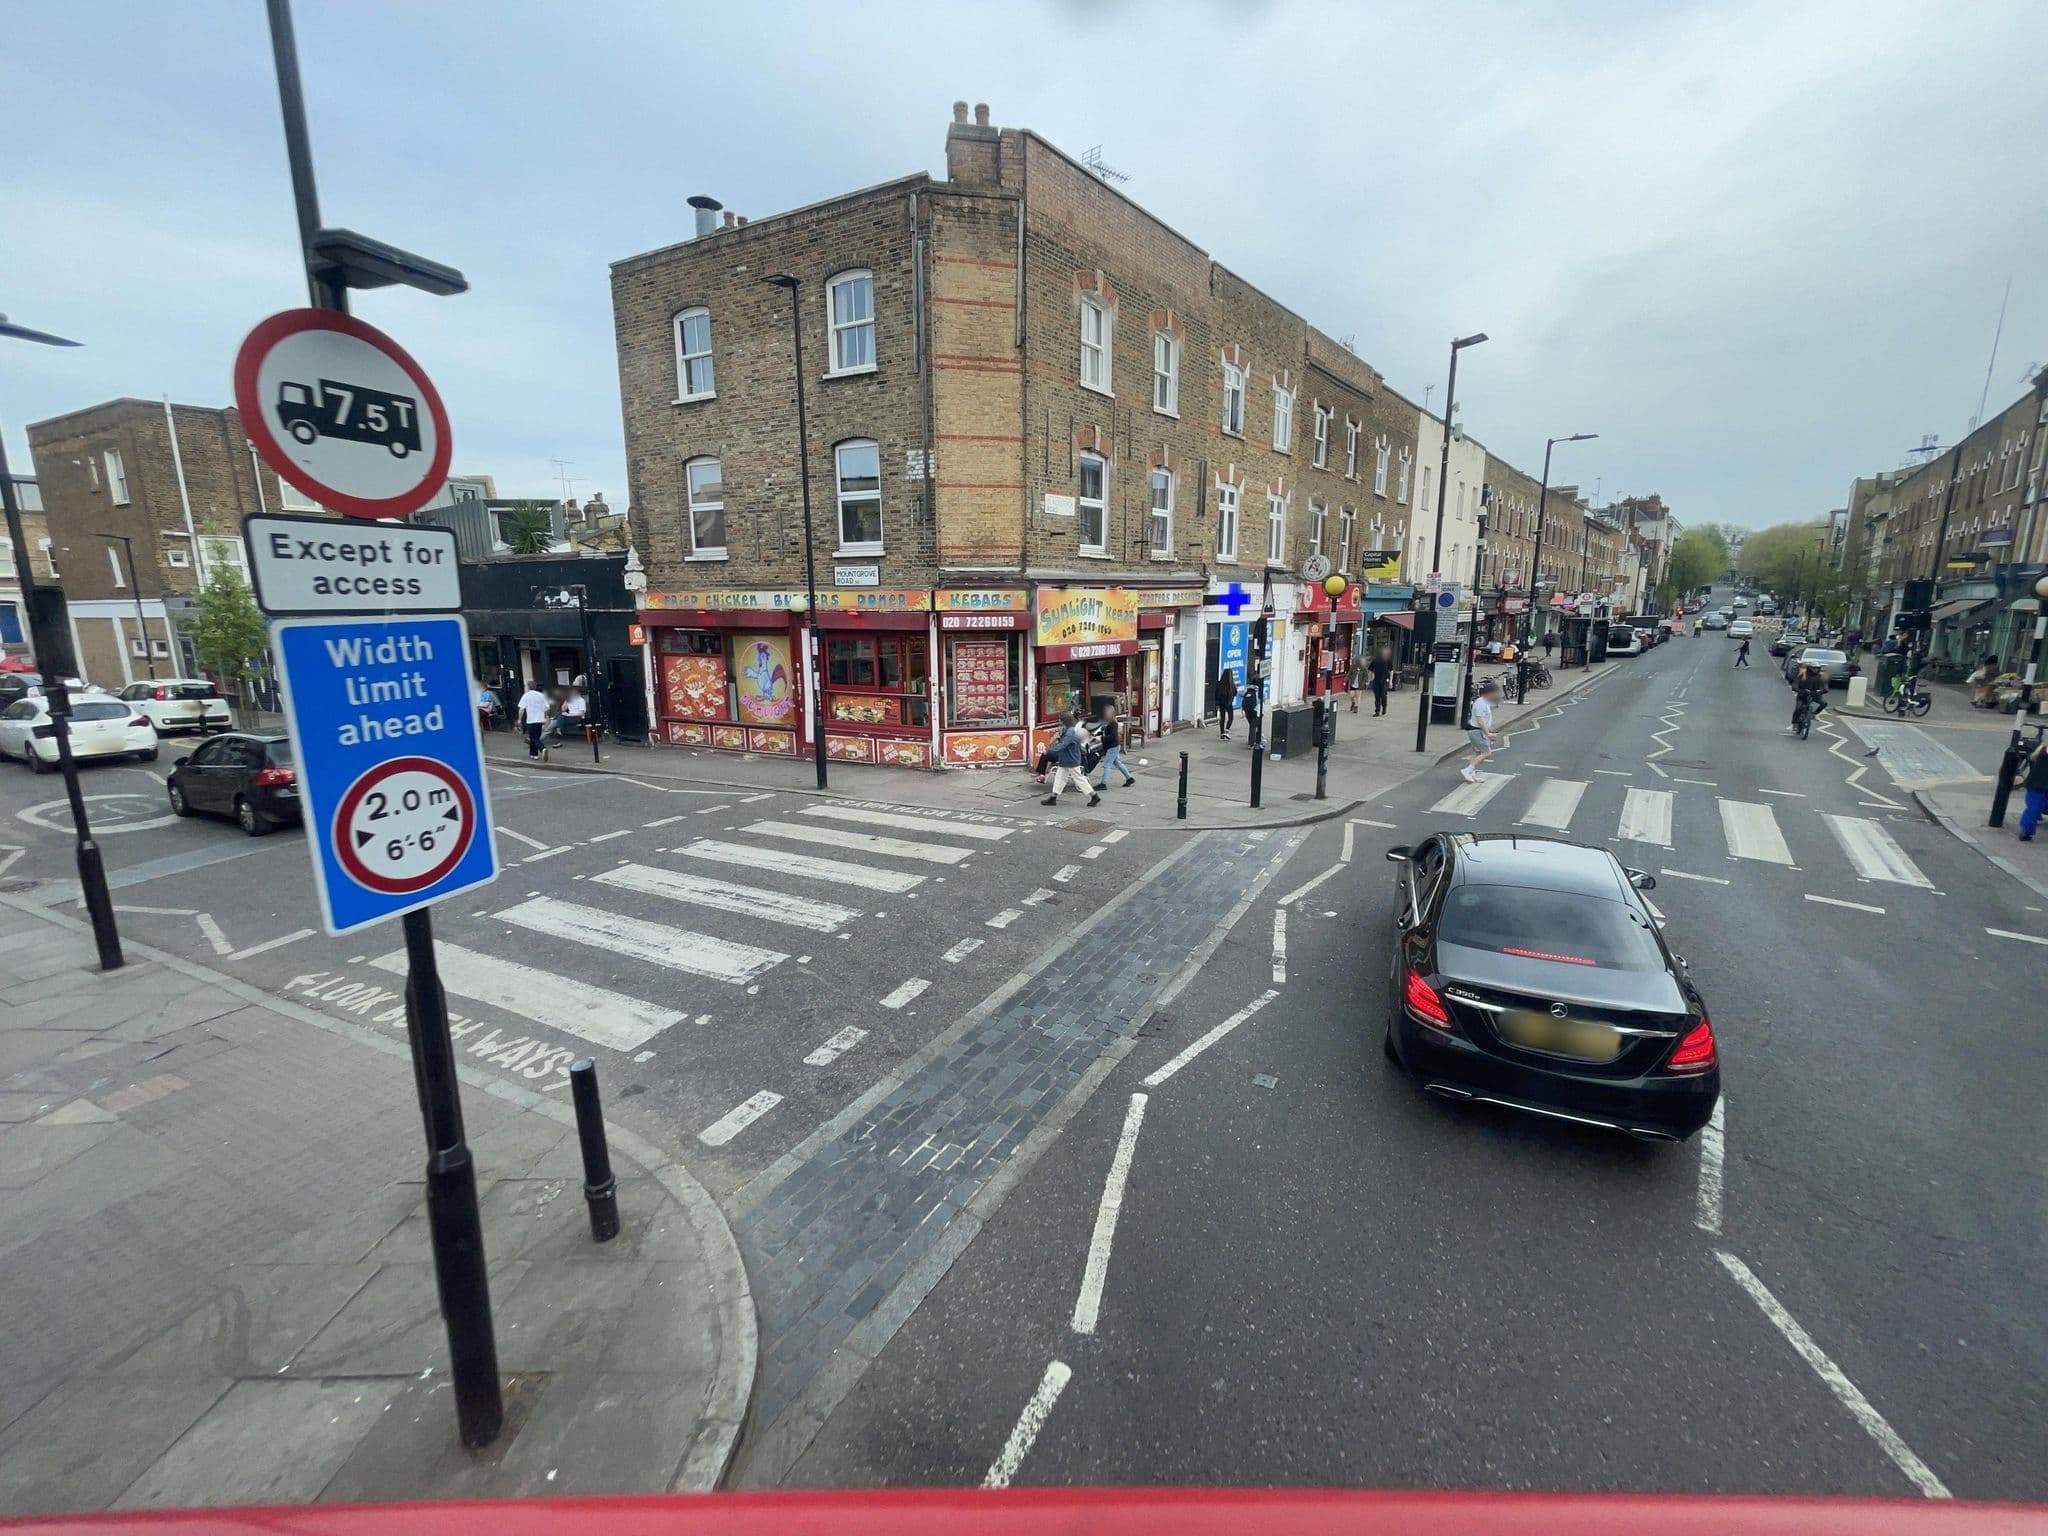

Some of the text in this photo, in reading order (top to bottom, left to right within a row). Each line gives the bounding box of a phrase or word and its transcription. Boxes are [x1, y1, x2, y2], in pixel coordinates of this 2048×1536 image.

[324, 386, 414, 433] 7.5T
[269, 532, 444, 567] Except for
[836, 570, 877, 578] MOUNTGROVE
[836, 577, 854, 585] ROAD
[312, 575, 422, 596] access
[949, 593, 1012, 608] KEBABS
[943, 616, 960, 628] 020
[1165, 614, 1175, 625] 177
[1062, 624, 1077, 639] 020
[323, 634, 433, 669] Width
[1078, 646, 1090, 657] 020
[344, 671, 428, 706] limit
[337, 704, 445, 746] ahead
[365, 787, 451, 821] 2.0 m
[302, 976, 576, 1079] LOOK BH WAYS
